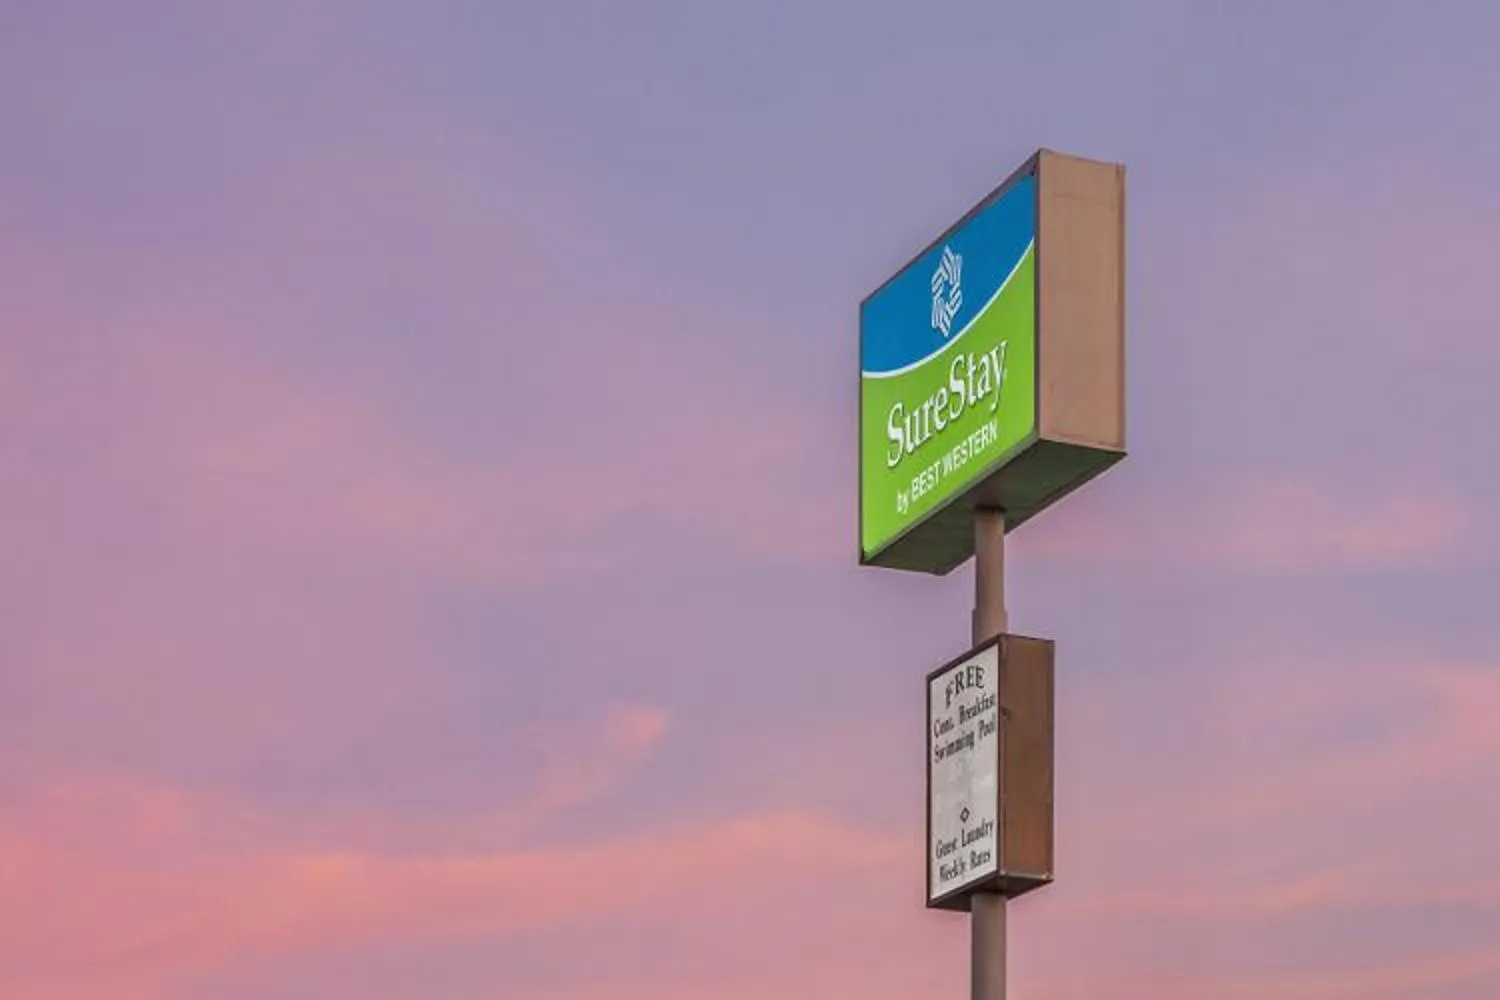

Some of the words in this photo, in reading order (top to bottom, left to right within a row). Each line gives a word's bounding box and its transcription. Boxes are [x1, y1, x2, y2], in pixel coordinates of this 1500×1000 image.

[887, 340, 1007, 467] SureStay
[897, 491, 909, 514] by
[911, 463, 941, 502] BEST
[943, 420, 998, 476] WESTERN
[946, 666, 985, 709] FREE
[933, 732, 975, 763] Swimming
[978, 713, 996, 740] Pool
[962, 818, 992, 848] Laundry
